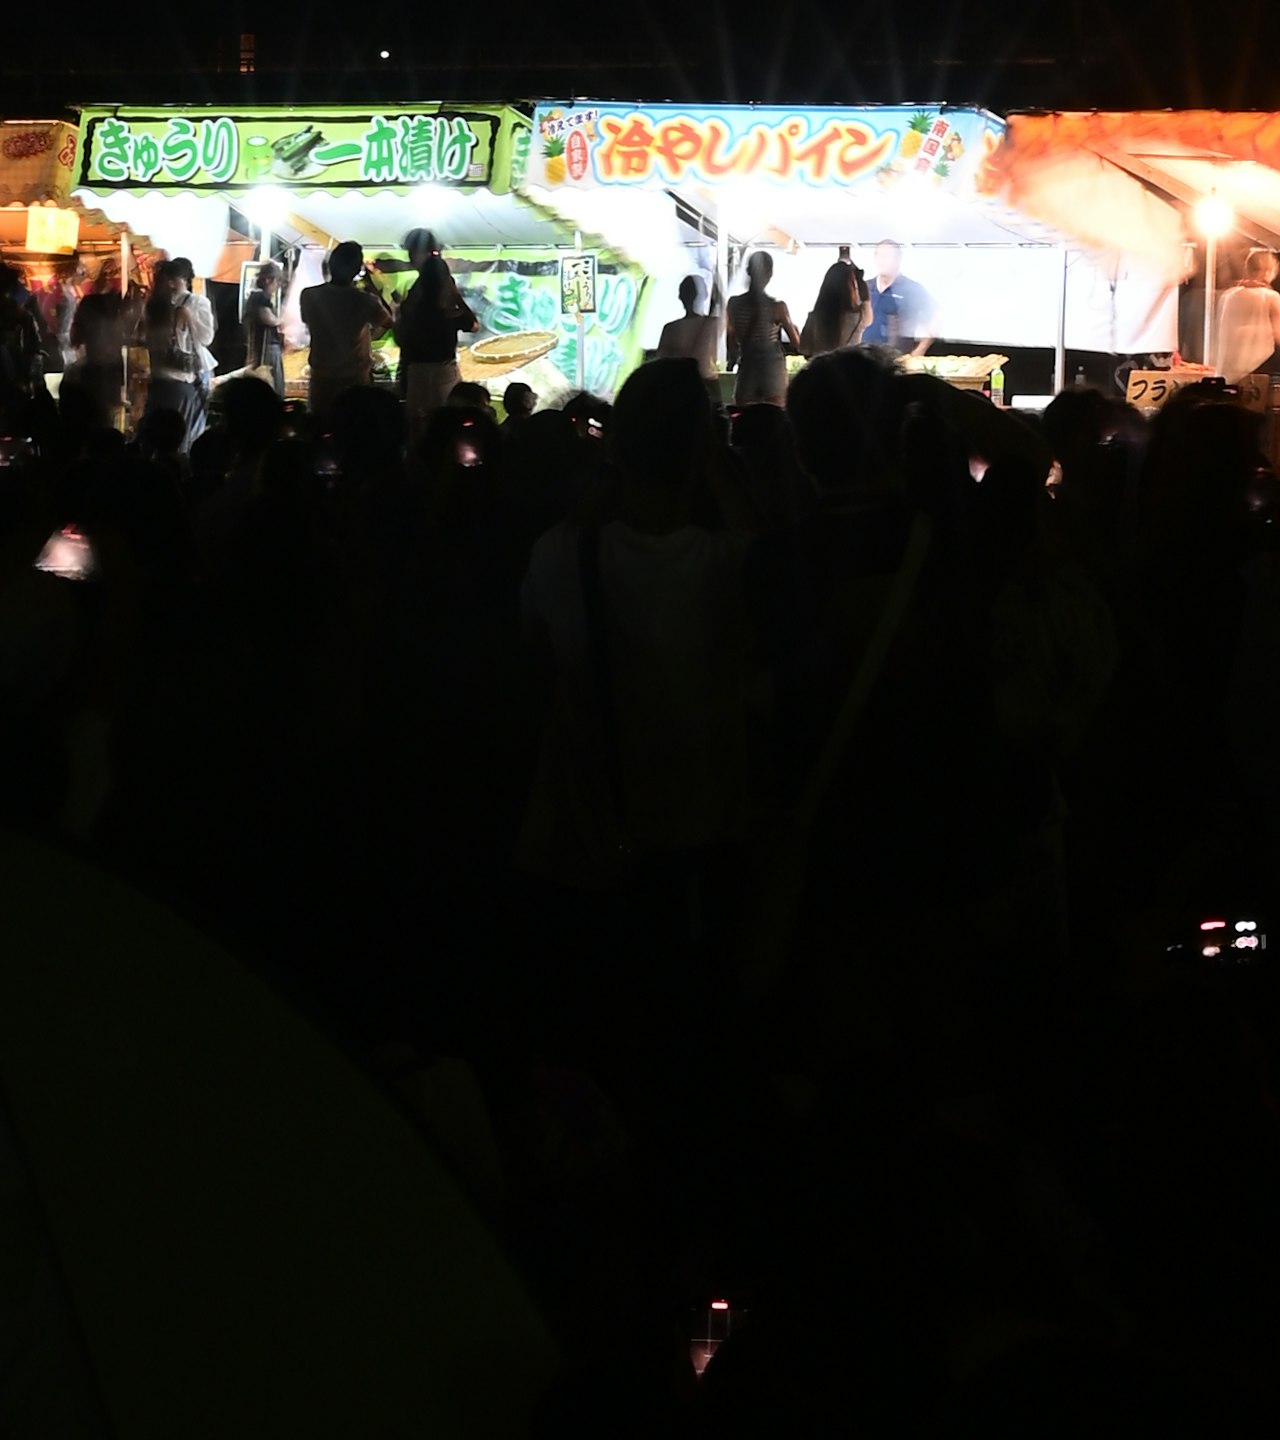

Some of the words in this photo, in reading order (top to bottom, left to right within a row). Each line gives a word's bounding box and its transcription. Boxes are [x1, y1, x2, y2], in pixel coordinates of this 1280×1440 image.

[97, 118, 237, 182] きゅうり
[310, 117, 476, 182] 一本漬け
[599, 118, 893, 178] 冷やしパイン
